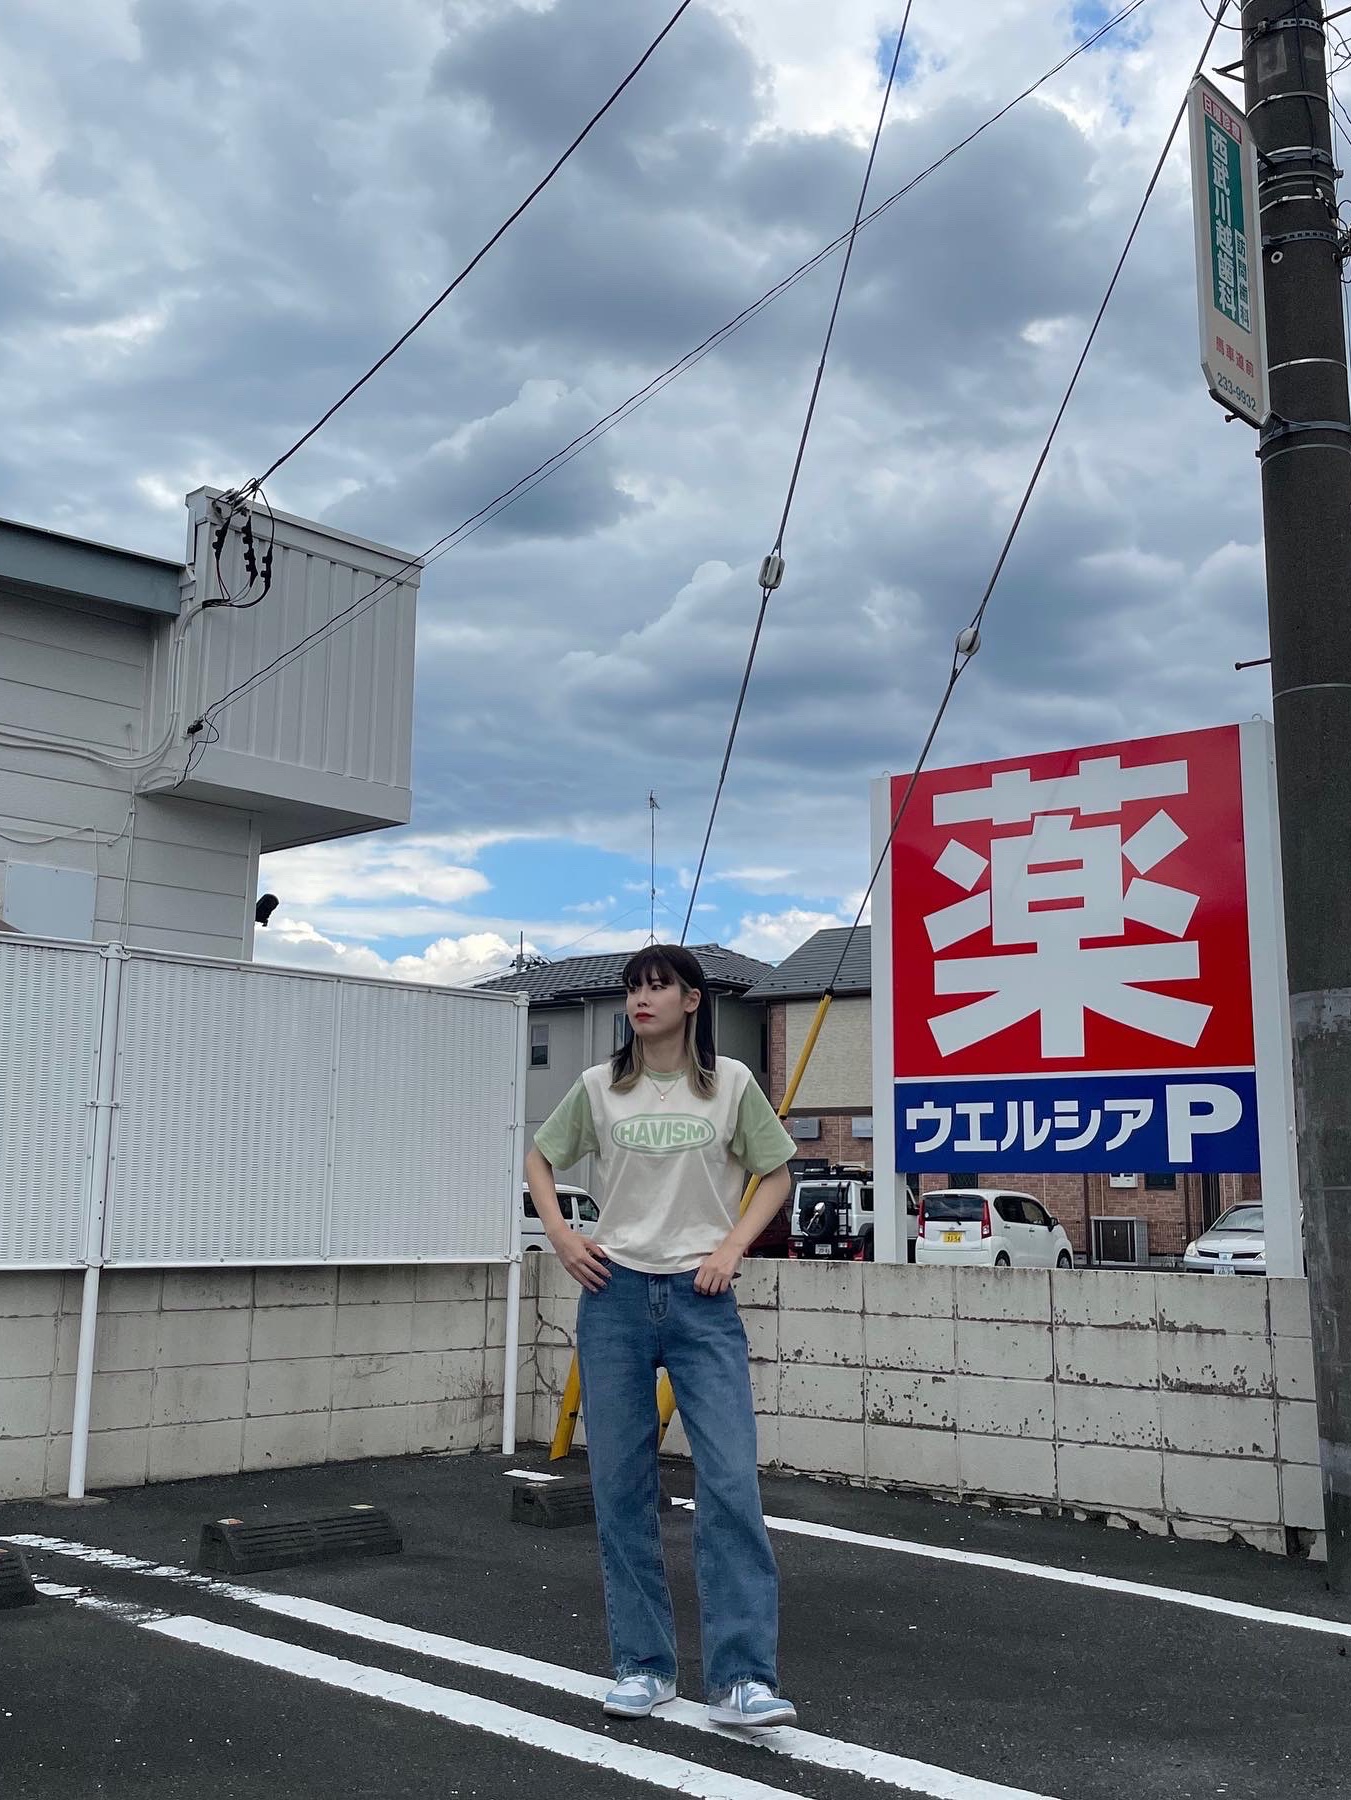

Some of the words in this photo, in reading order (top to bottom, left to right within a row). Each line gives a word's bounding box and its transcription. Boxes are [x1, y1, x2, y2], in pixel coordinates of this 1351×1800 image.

[1210, 125, 1237, 320] 西武川越歯科
[1217, 372, 1257, 413] 233-9932
[923, 755, 1213, 1058] 薬
[620, 1121, 705, 1145] HAVISM
[906, 1099, 1154, 1153] ウエルシア
[1165, 1084, 1243, 1163] P
